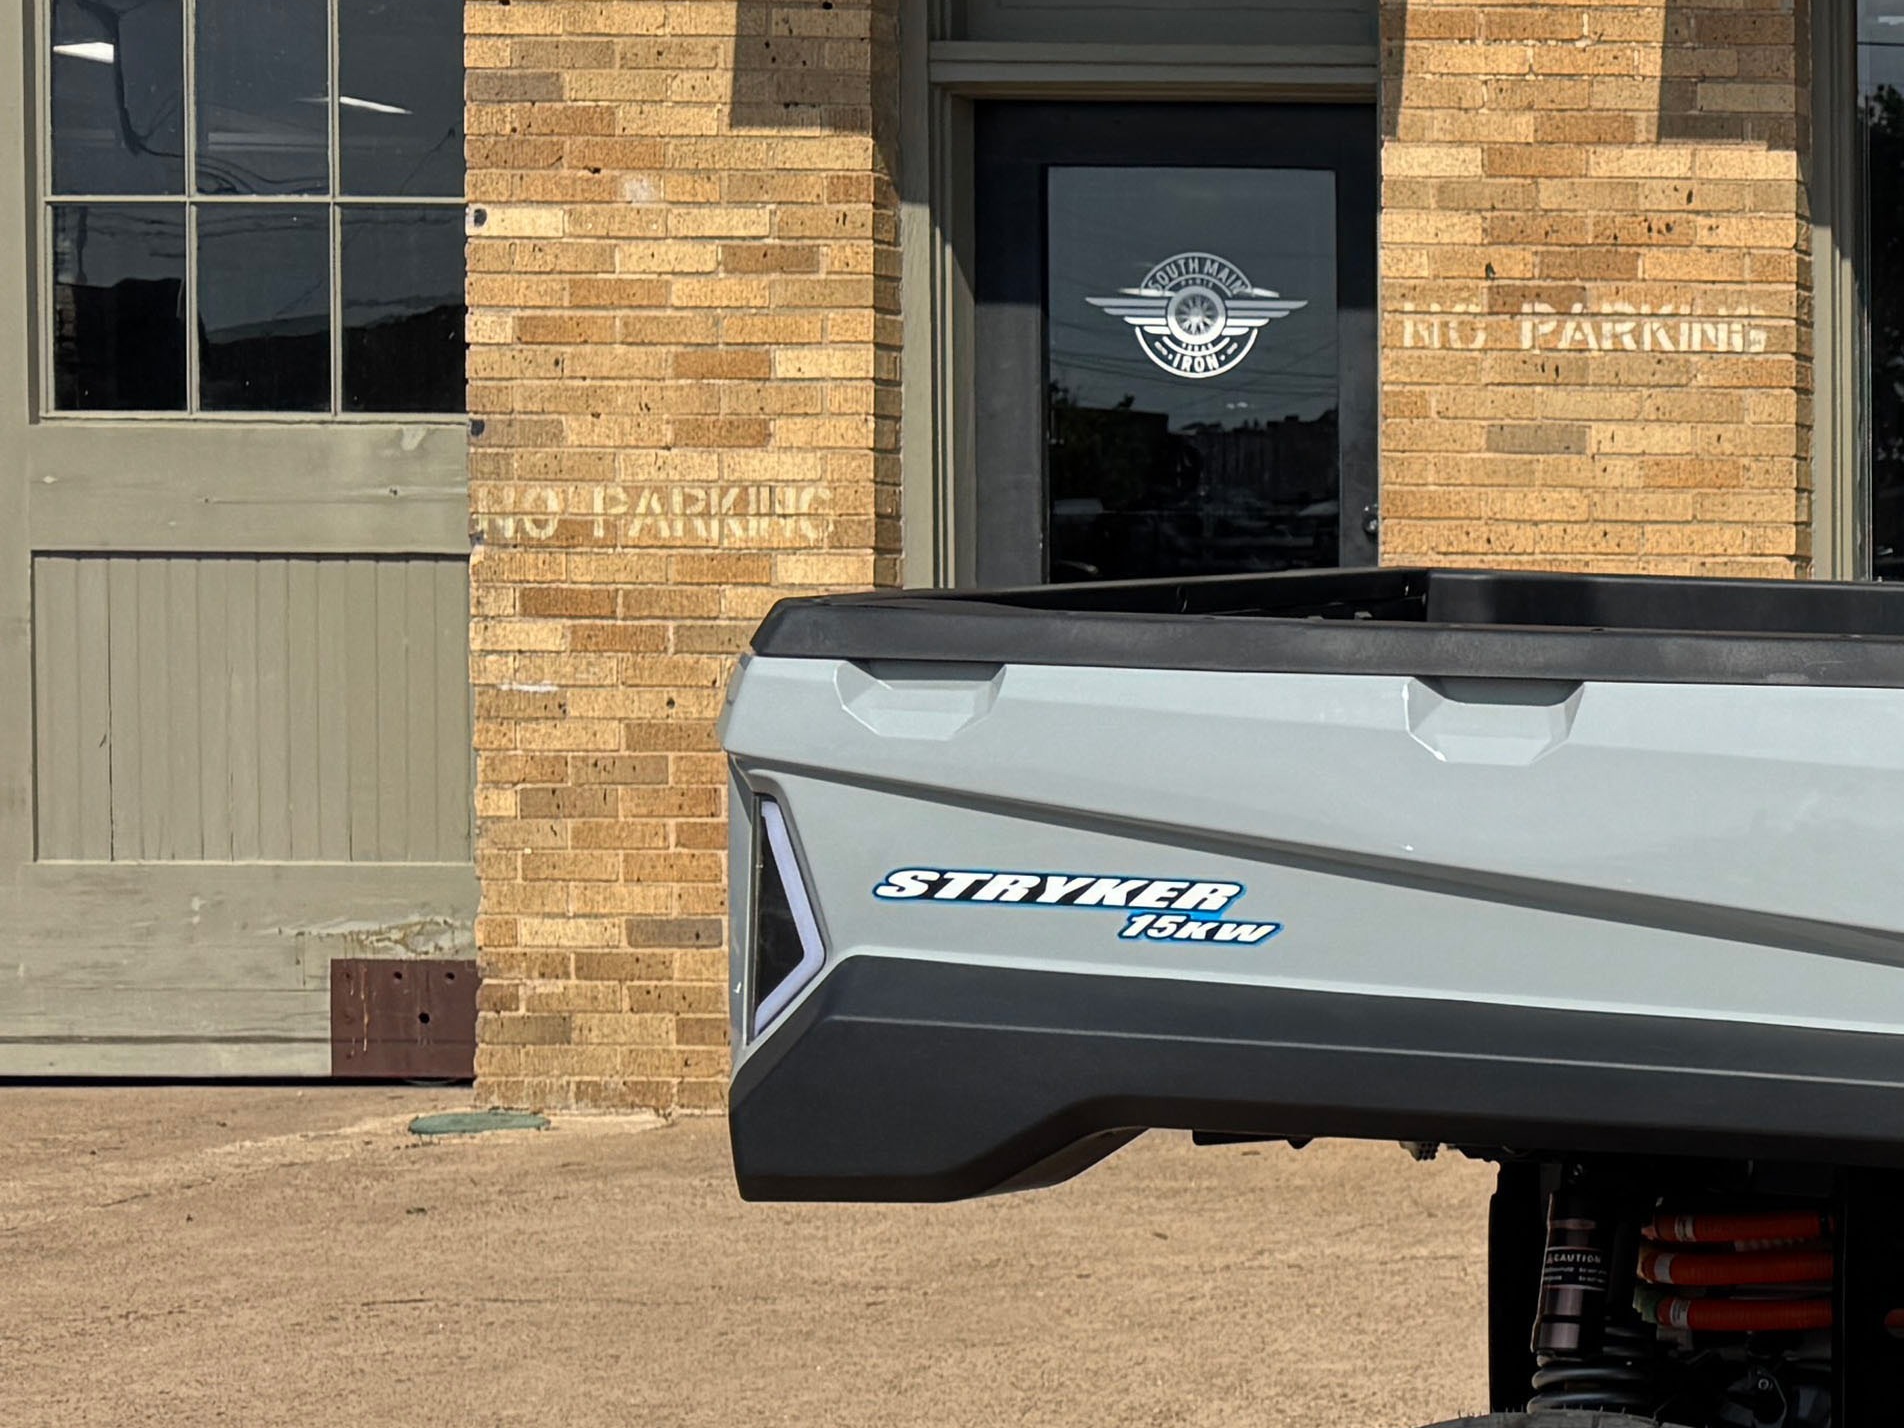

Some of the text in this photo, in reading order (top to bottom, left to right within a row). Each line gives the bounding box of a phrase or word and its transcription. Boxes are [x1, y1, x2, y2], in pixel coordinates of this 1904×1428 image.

[1148, 256, 1248, 295] SOUTH MAIN
[1402, 301, 1769, 353] NO PARKING
[1172, 354, 1219, 372] IRON
[478, 484, 834, 546] NO PARKING
[874, 869, 1244, 911] STRYKER
[1121, 913, 1278, 943] 15KW
[1553, 1253, 1601, 1263] CAUTION
